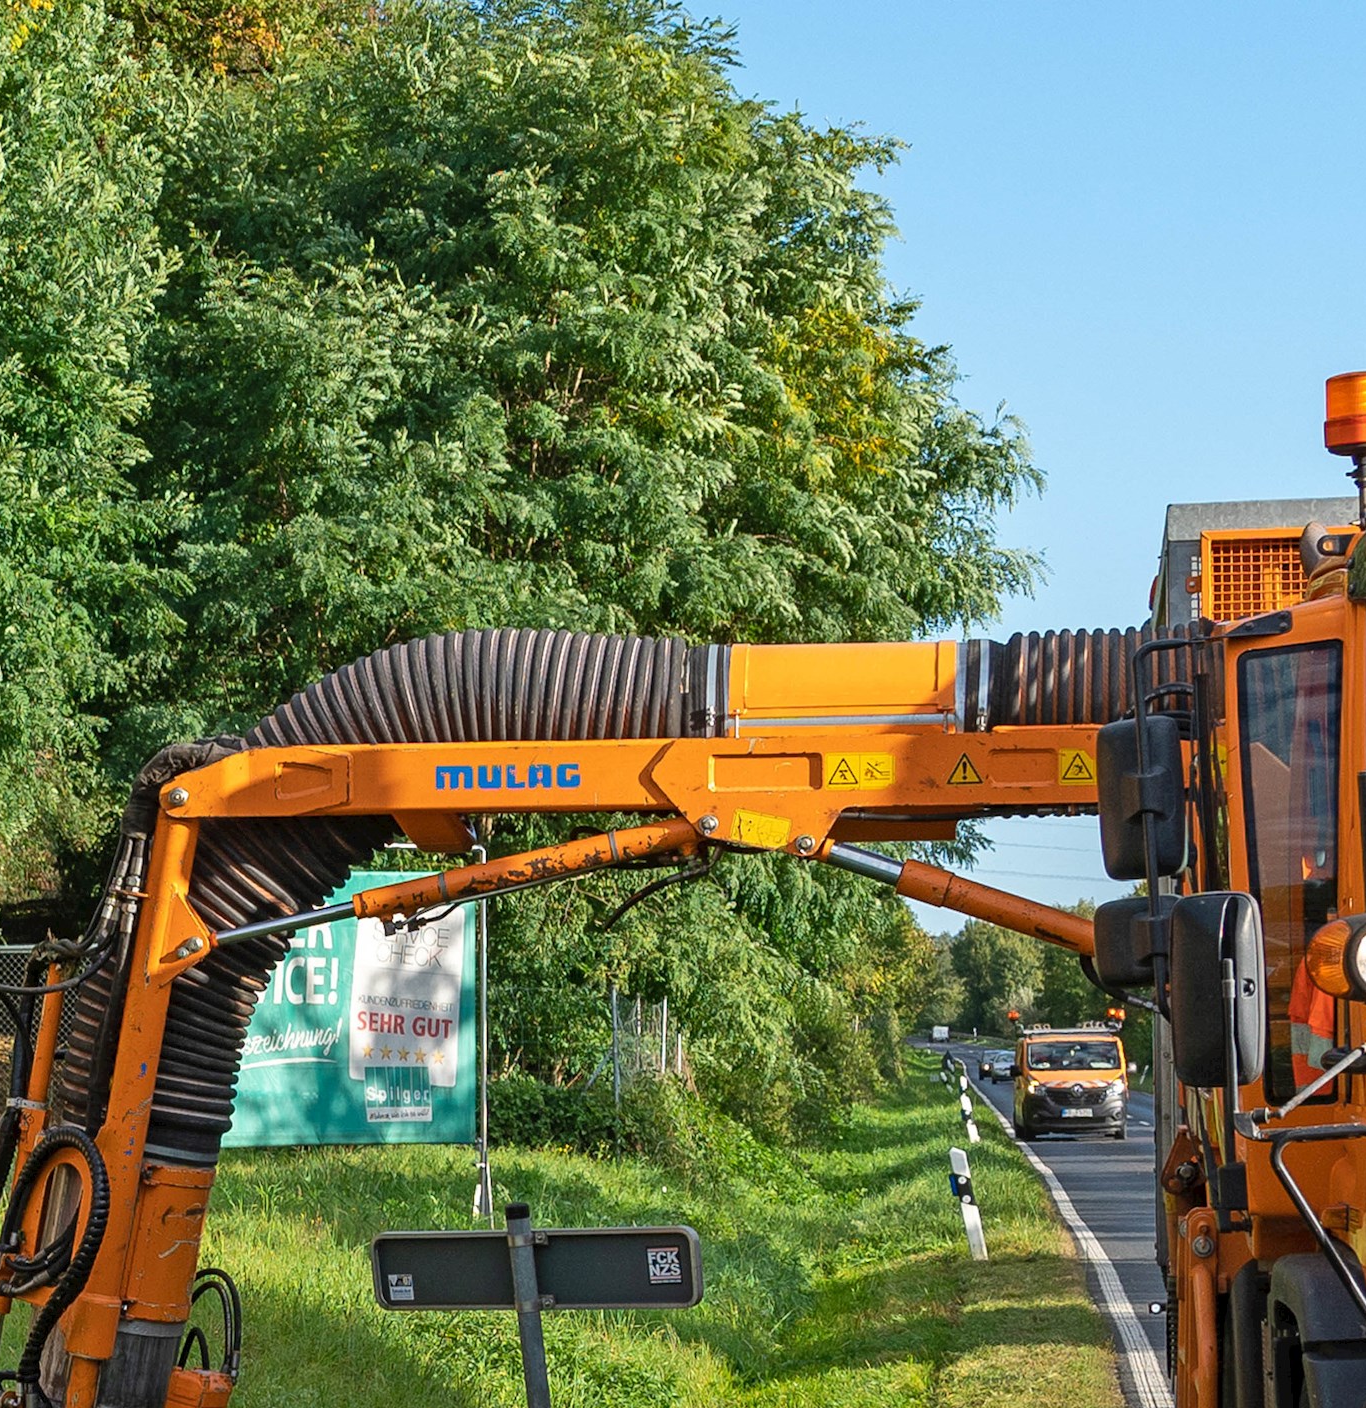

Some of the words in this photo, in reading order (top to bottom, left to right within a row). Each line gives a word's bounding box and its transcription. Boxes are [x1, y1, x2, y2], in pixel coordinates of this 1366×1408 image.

[435, 763, 581, 790] MULAG
[376, 942, 444, 968] CHECK
[357, 994, 454, 1013] KUNDENZUFRIEDENHEIT
[357, 1010, 405, 1036] SEHR
[412, 1016, 454, 1040] GUT
[238, 1016, 343, 1057] szeichnung!
[365, 1086, 430, 1105] Spilger
[647, 1251, 679, 1265] FCK
[648, 1264, 681, 1277] NZS
